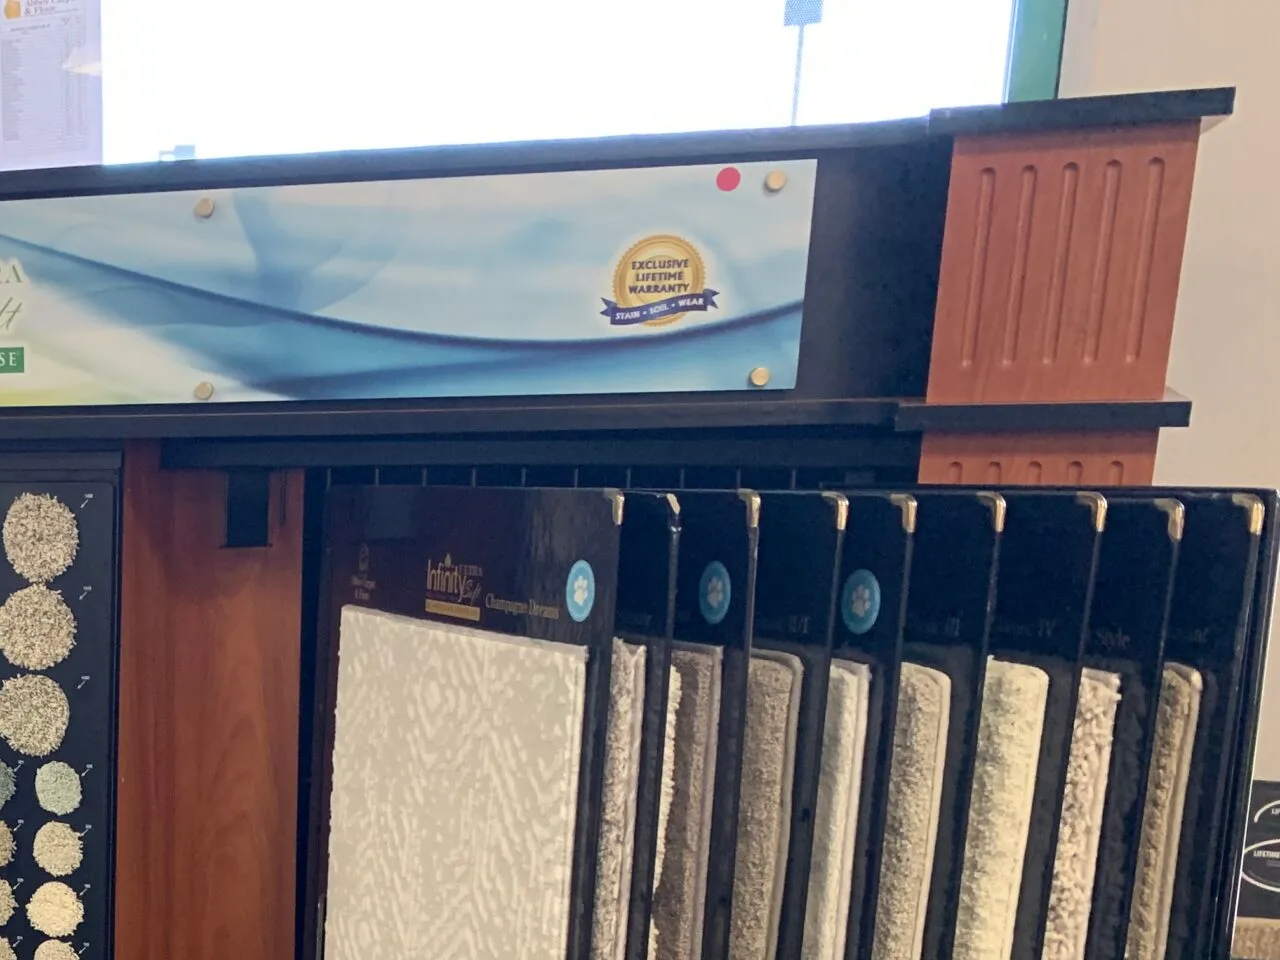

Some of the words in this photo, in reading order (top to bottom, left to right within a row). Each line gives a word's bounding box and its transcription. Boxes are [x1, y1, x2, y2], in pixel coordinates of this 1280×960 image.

[631, 259, 689, 270] EXCLUSIVE
[635, 271, 684, 282] LIFETIME
[628, 283, 690, 294] WARRANTY
[615, 310, 640, 320] STAIN
[678, 298, 704, 307] WEAR
[426, 559, 467, 603] Infinity
[485, 593, 528, 616] Champagne
